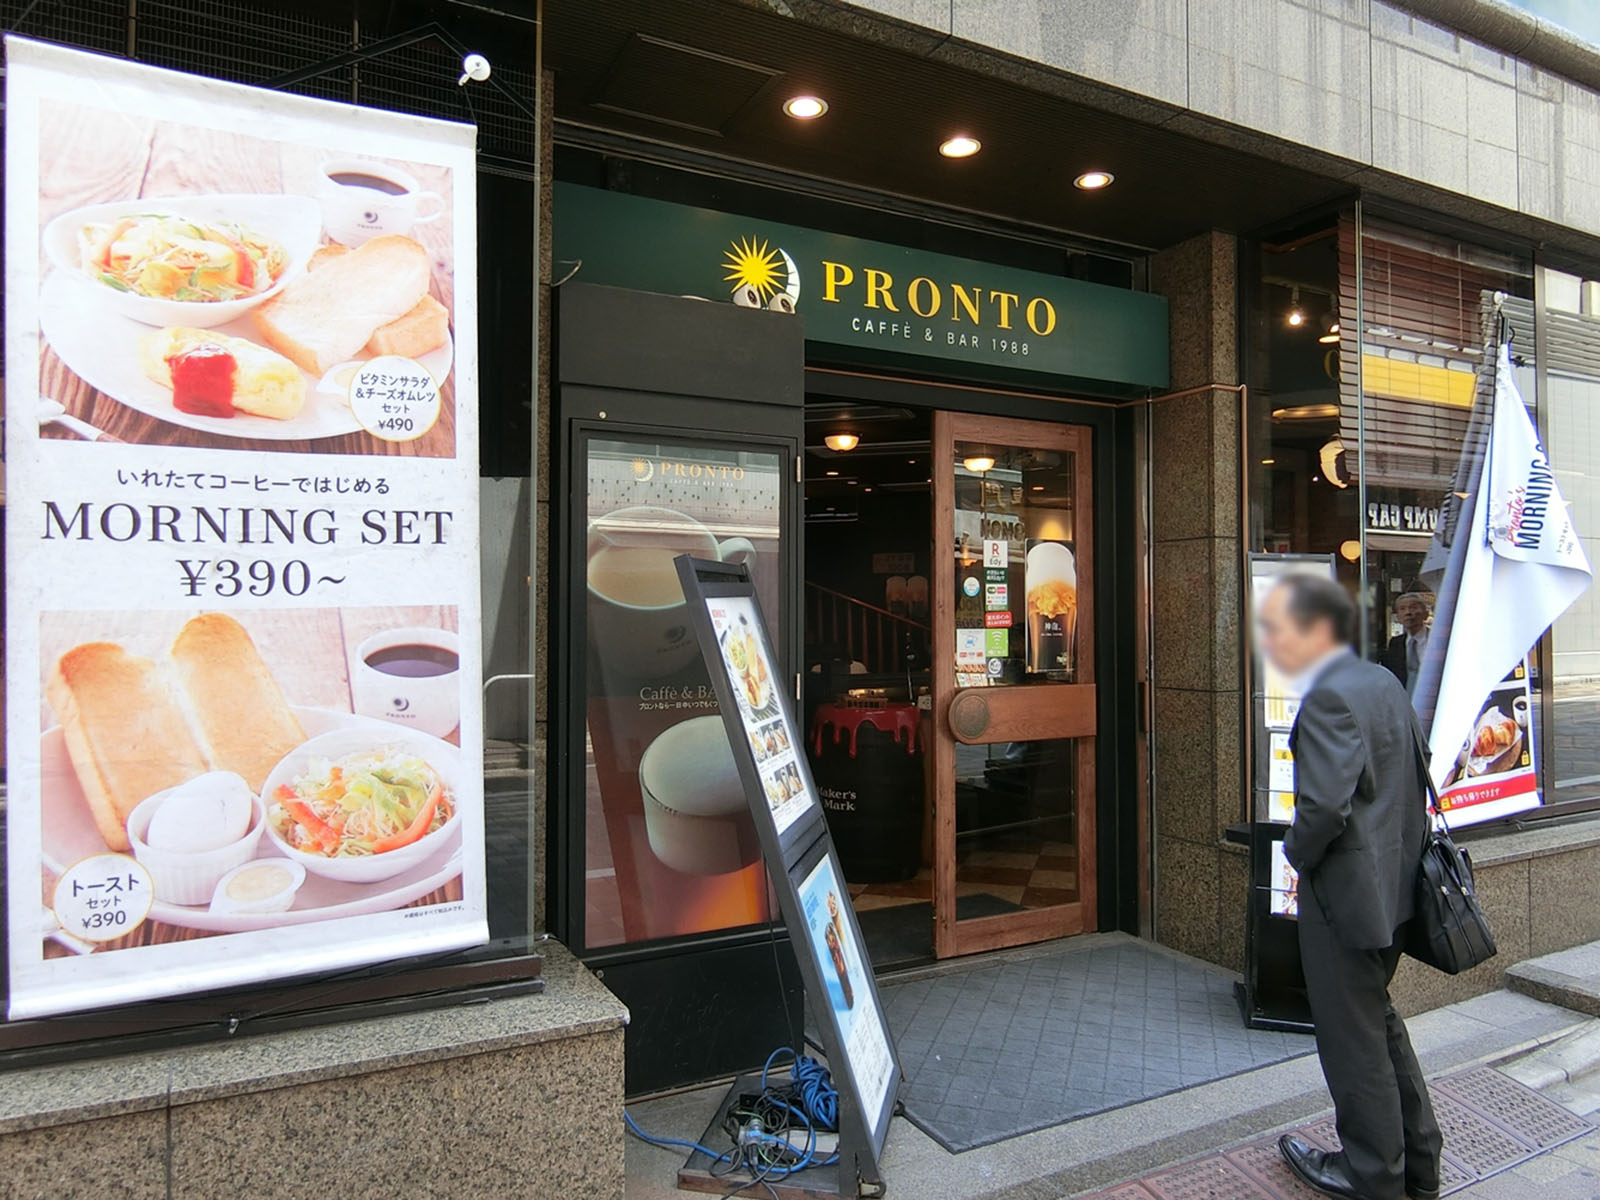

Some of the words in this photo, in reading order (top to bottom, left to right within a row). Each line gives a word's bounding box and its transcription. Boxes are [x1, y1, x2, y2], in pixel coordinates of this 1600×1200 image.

[821, 260, 1057, 336] PRONTO
[851, 317, 912, 340] CAFFÈ
[924, 327, 934, 342] &
[946, 331, 980, 349] BAR
[991, 337, 1030, 356] 1988
[360, 373, 430, 389] ビタミンサラダ
[355, 387, 436, 402] &チーズオムレツ
[381, 403, 410, 414] セット
[378, 417, 414, 432] ¥490
[660, 460, 745, 481] PRONTO
[117, 468, 391, 495] いれたてコーヒーではじめる
[41, 500, 340, 545] MORNING
[360, 509, 454, 545] SET
[639, 686, 678, 701] Caffè
[681, 685, 693, 699] &
[824, 799, 856, 811] Mark
[72, 873, 140, 897] トースト
[85, 895, 122, 910] セット
[81, 910, 127, 929] ¥390
